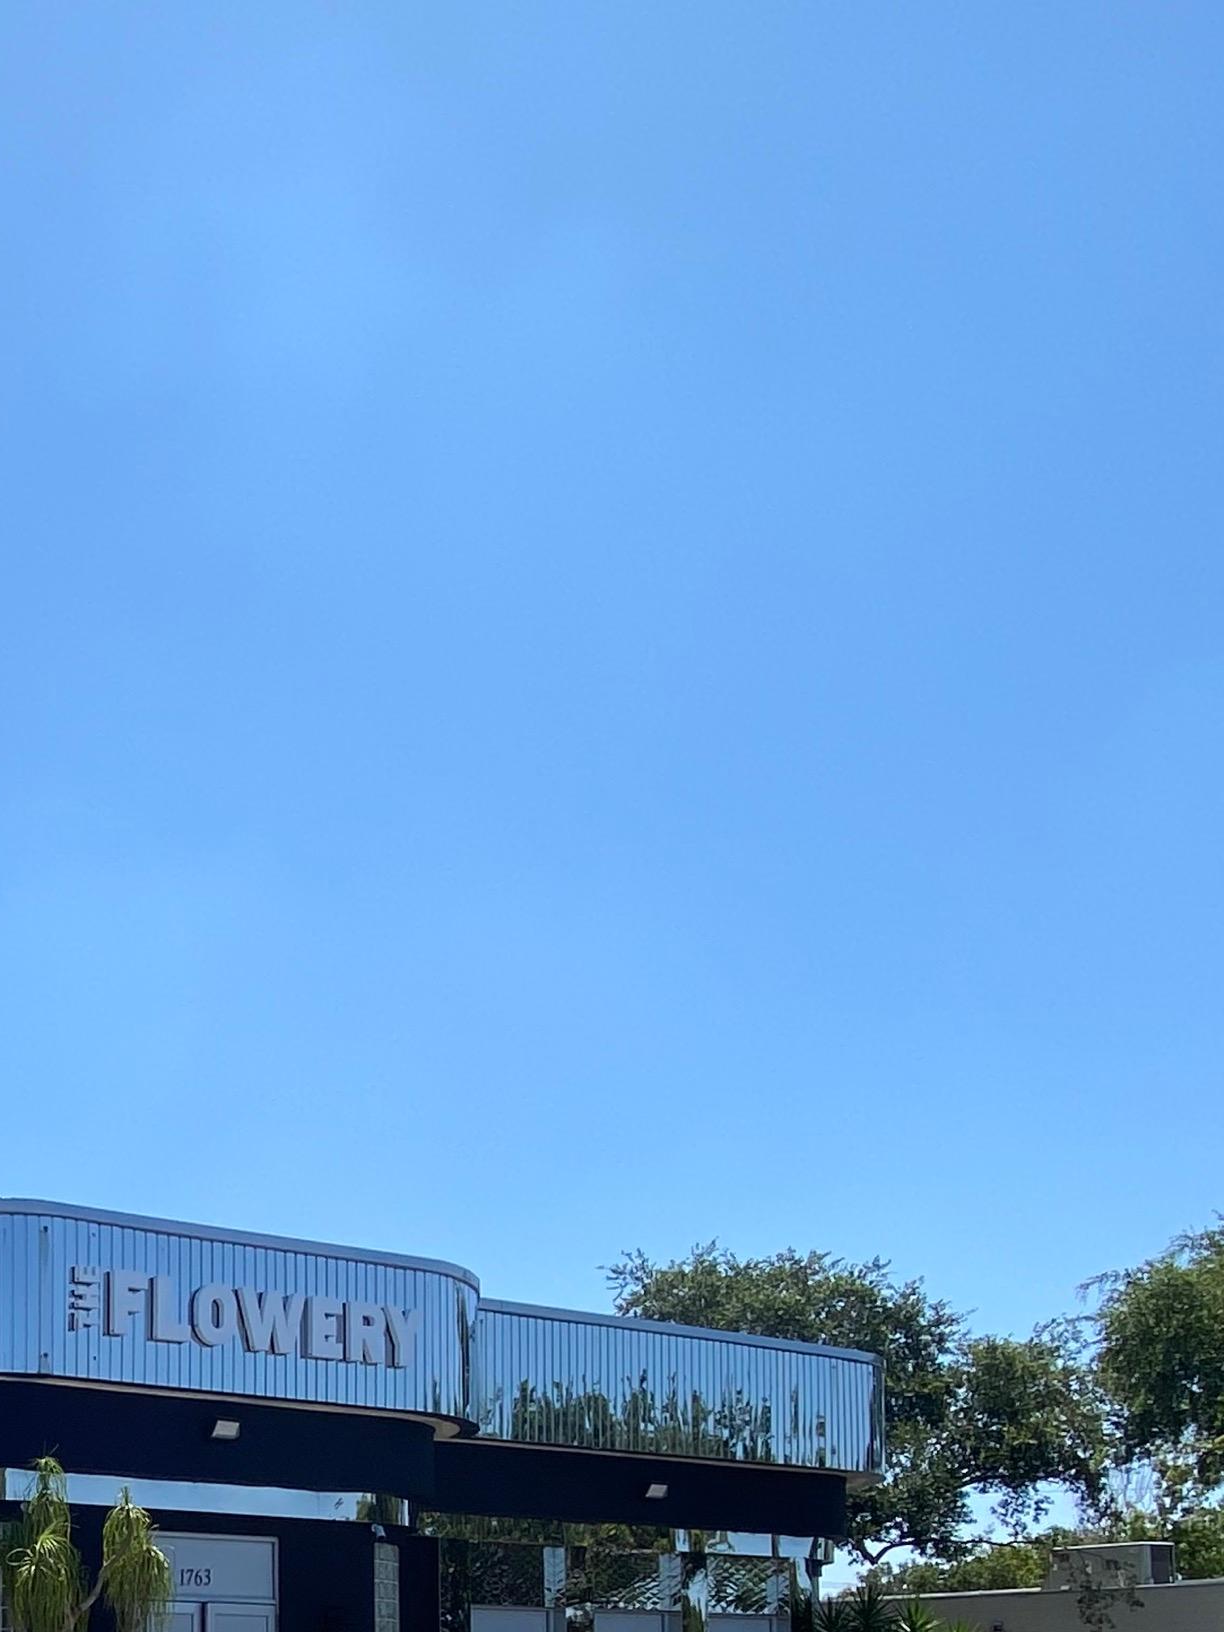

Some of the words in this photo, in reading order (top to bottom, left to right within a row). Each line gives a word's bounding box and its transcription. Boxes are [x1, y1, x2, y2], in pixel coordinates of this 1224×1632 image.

[68, 1264, 101, 1332] THE
[103, 1268, 418, 1369] FLOWERY
[179, 1568, 212, 1587] 1763
